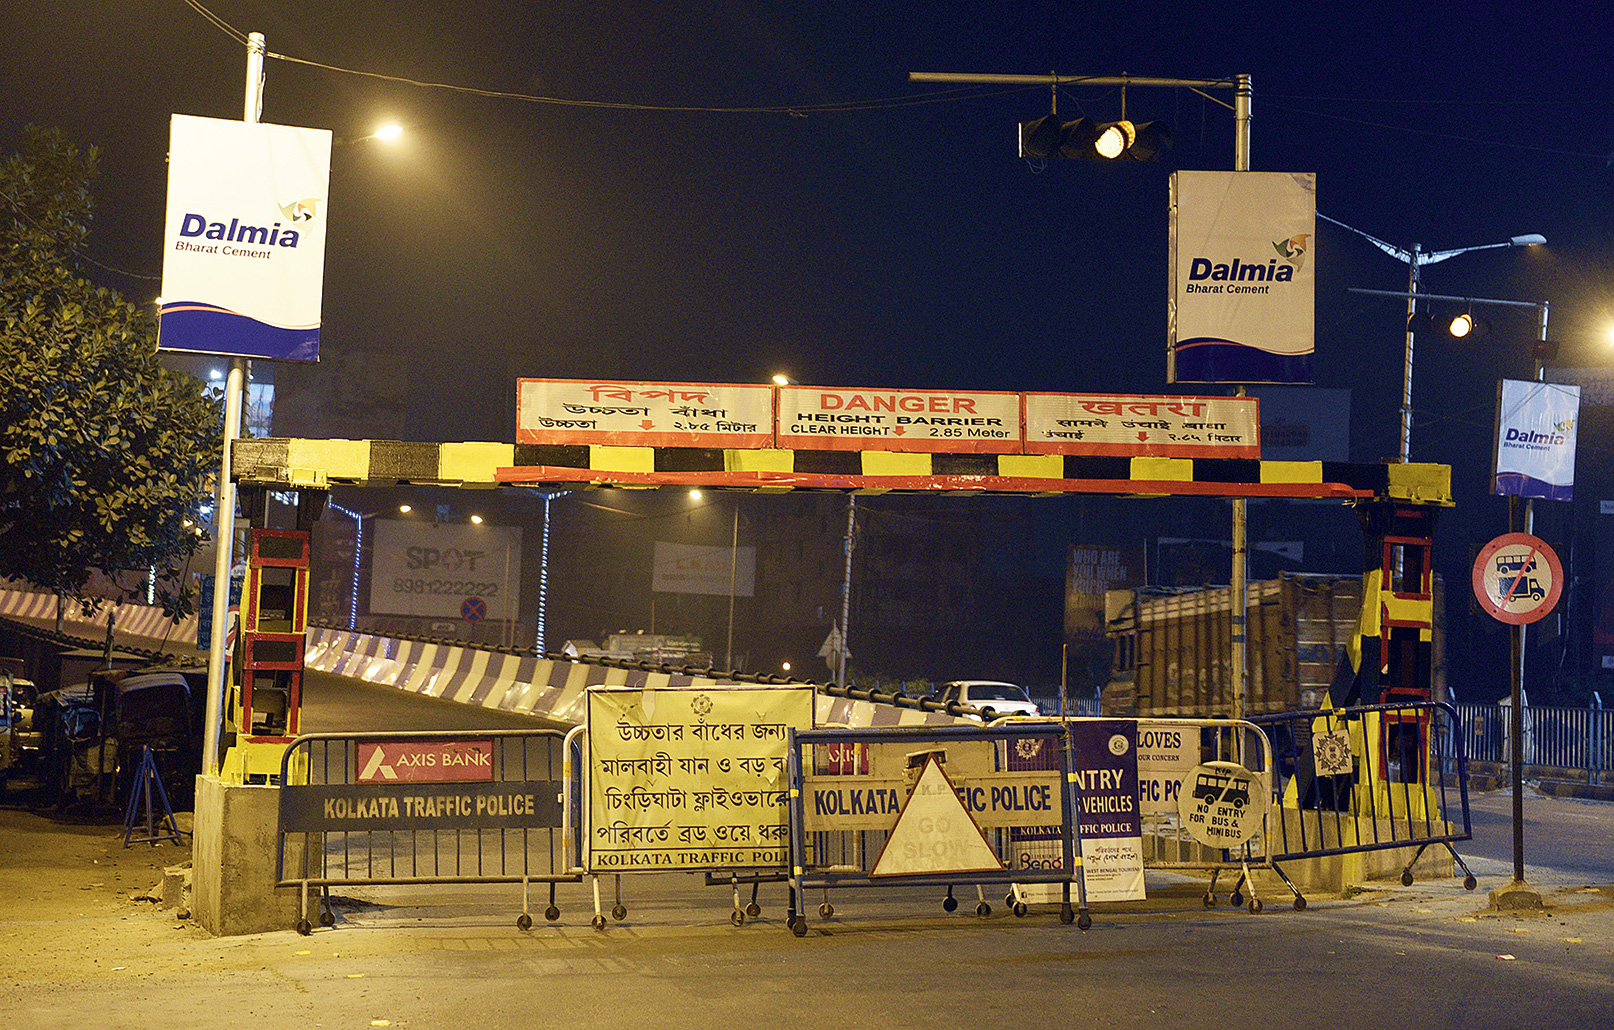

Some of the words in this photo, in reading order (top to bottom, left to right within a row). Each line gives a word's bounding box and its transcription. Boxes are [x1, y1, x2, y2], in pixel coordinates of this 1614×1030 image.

[179, 213, 301, 248] Dalmia
[175, 240, 218, 255] Bharat
[222, 244, 271, 260] Cement
[1188, 257, 1294, 282] Dalmia
[1186, 283, 1223, 294] Bharat
[1226, 284, 1270, 294] Cement
[583, 385, 711, 404] বিপদ
[820, 393, 978, 414] DANGER
[562, 403, 650, 417] উচ্চতা
[1078, 400, 1207, 417] खतरा
[538, 416, 598, 430] উচ্চতা
[716, 420, 758, 433] মিটার
[797, 413, 886, 424] HEIGHT
[896, 416, 1003, 427] BARRIER
[790, 424, 836, 435] CLEAR
[840, 425, 890, 436] HEIGHT
[930, 428, 962, 437] 2.85
[968, 428, 1010, 438] Meter
[1505, 428, 1564, 445] Dalmia
[1503, 441, 1525, 449] Bharat
[1526, 443, 1551, 451] Cement
[406, 545, 485, 571] SPOT
[616, 718, 684, 741] উচ্চতার
[689, 718, 745, 741] বাঁধের
[751, 723, 787, 741] জন্য
[396, 753, 436, 767] AXIS
[442, 752, 491, 767] BANK
[600, 751, 673, 776] মালবাহী
[678, 757, 709, 775] যান
[716, 757, 731, 773] ও
[737, 757, 765, 777] বড়
[770, 757, 788, 775] বা
[1152, 754, 1180, 762] CONCERN
[1075, 768, 1124, 791] NTRY
[604, 786, 687, 812] চিংড়িঘাটা
[692, 786, 789, 811] ফ্লাইওভারে
[1138, 779, 1160, 802] FIC
[1164, 780, 1182, 802] PO
[323, 796, 400, 819] KOLKATA
[403, 795, 472, 818] TRAFFIC
[476, 794, 535, 816] POLICE
[814, 788, 900, 816] KOLKATA
[991, 785, 1052, 812] POLICE
[1083, 795, 1133, 814] VEHICLES
[1189, 813, 1205, 823] FOR
[1212, 816, 1229, 827] BUS
[1231, 819, 1239, 828] &
[1196, 804, 1209, 814] NO
[1217, 807, 1246, 818] ENTRY
[597, 819, 673, 844] পরিবর্তে
[678, 825, 708, 844] ব্রড
[714, 825, 751, 843] ওয়ে
[758, 824, 789, 842] ধরু
[919, 817, 951, 834] GO
[1079, 824, 1100, 834] FFIC
[1101, 823, 1132, 833] POLICE
[597, 853, 673, 866] KOLKATA
[677, 852, 745, 864] TRAFFIC
[752, 851, 789, 863] POLI
[903, 840, 968, 859] SLOW
